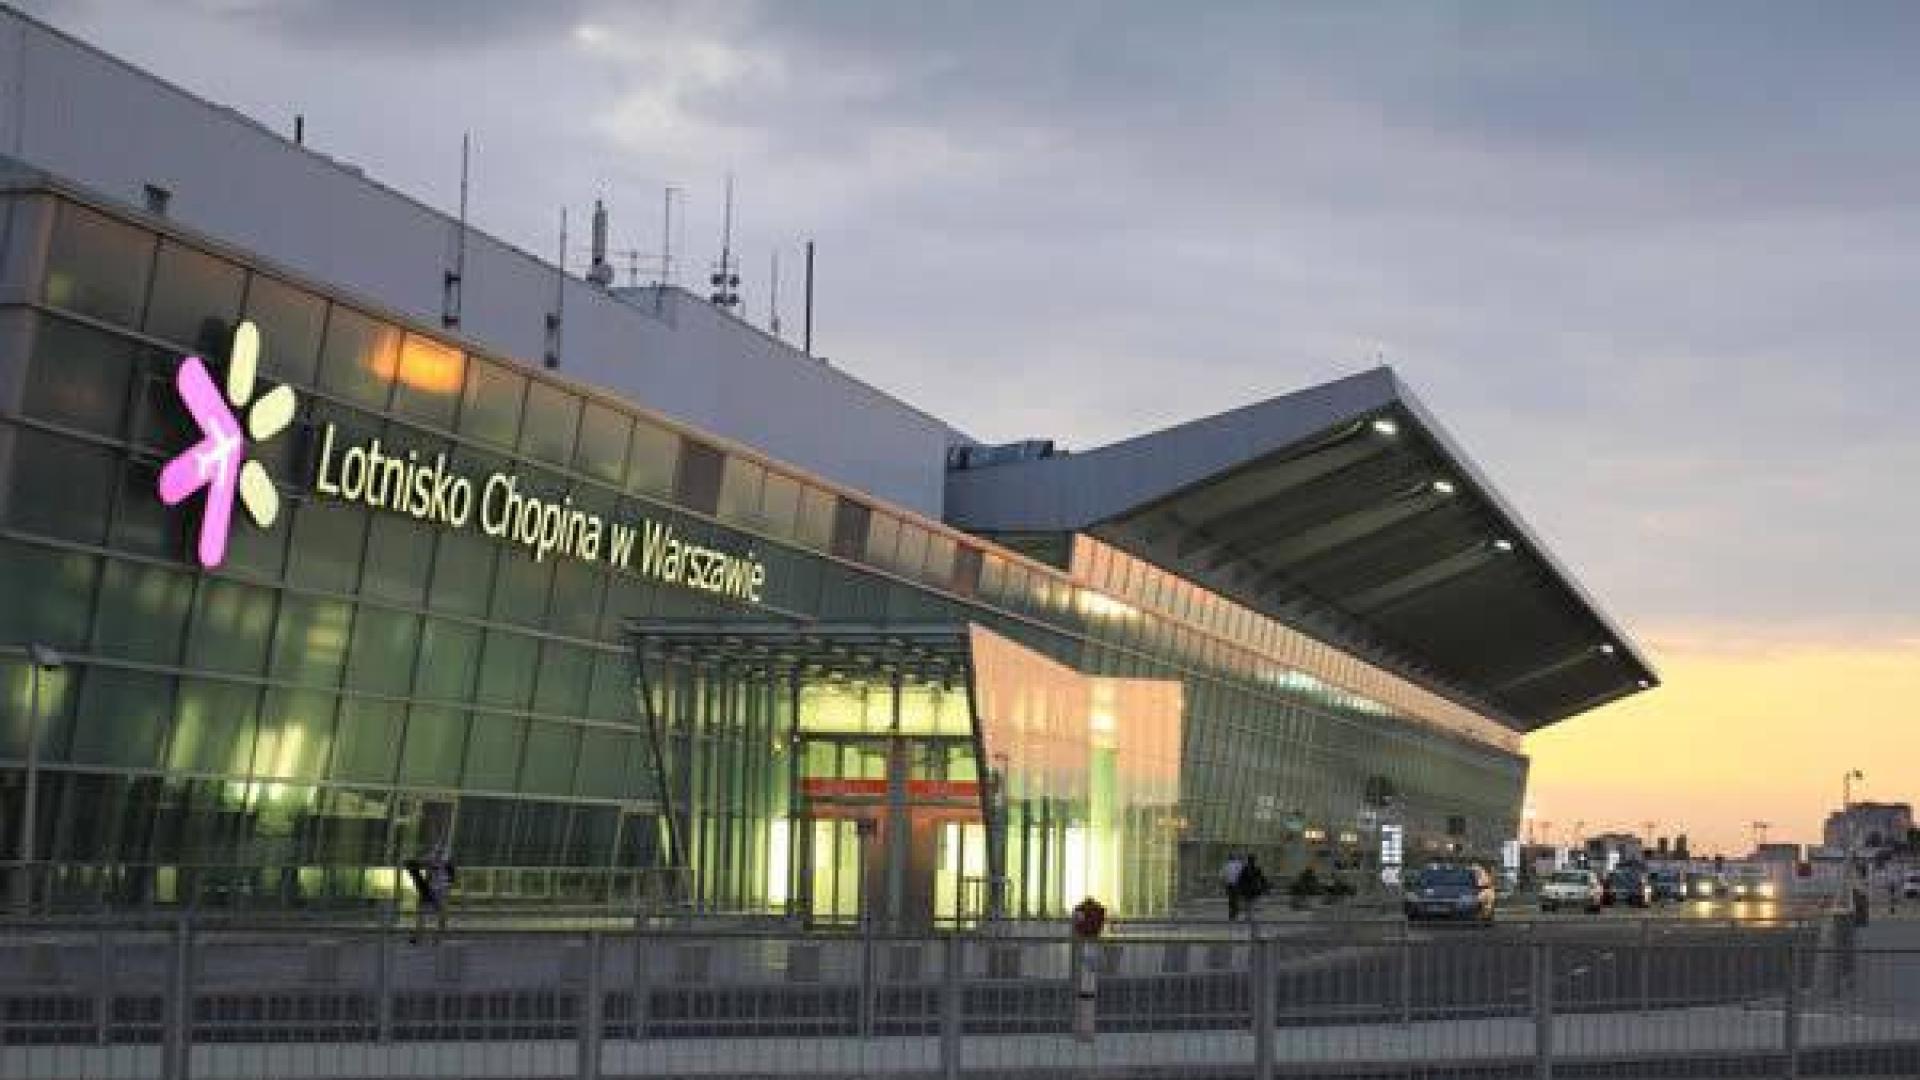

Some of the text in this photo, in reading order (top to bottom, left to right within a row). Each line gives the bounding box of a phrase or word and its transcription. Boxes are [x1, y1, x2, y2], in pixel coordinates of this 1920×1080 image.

[317, 422, 766, 602] Lotnisko Chopina w Warszawie
